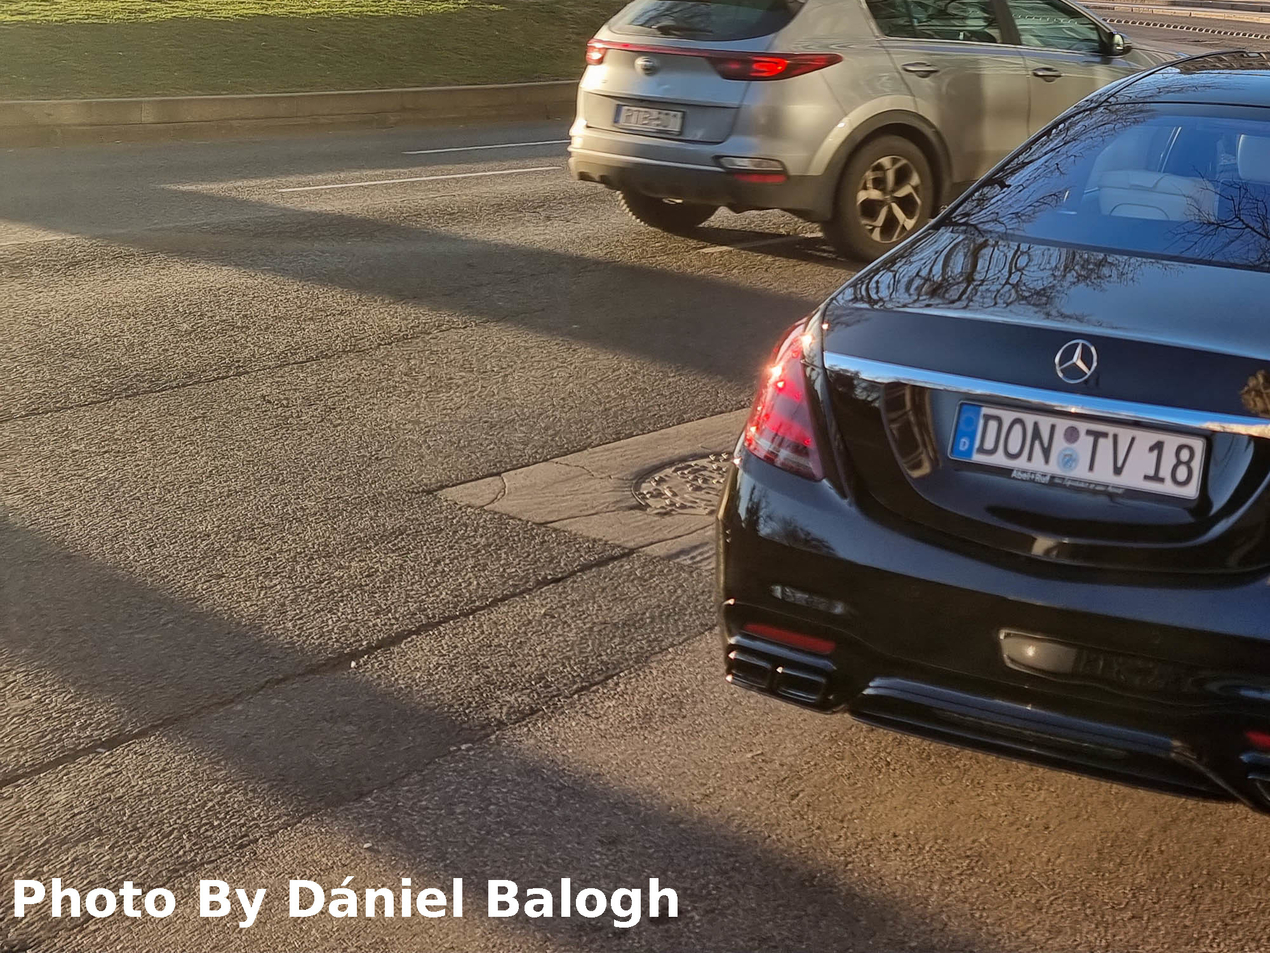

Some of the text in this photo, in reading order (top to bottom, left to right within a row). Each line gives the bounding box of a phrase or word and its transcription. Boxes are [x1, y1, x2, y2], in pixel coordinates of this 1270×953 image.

[975, 413, 1056, 464] DON
[1085, 429, 1136, 476] TV
[1143, 440, 1196, 487] 18
